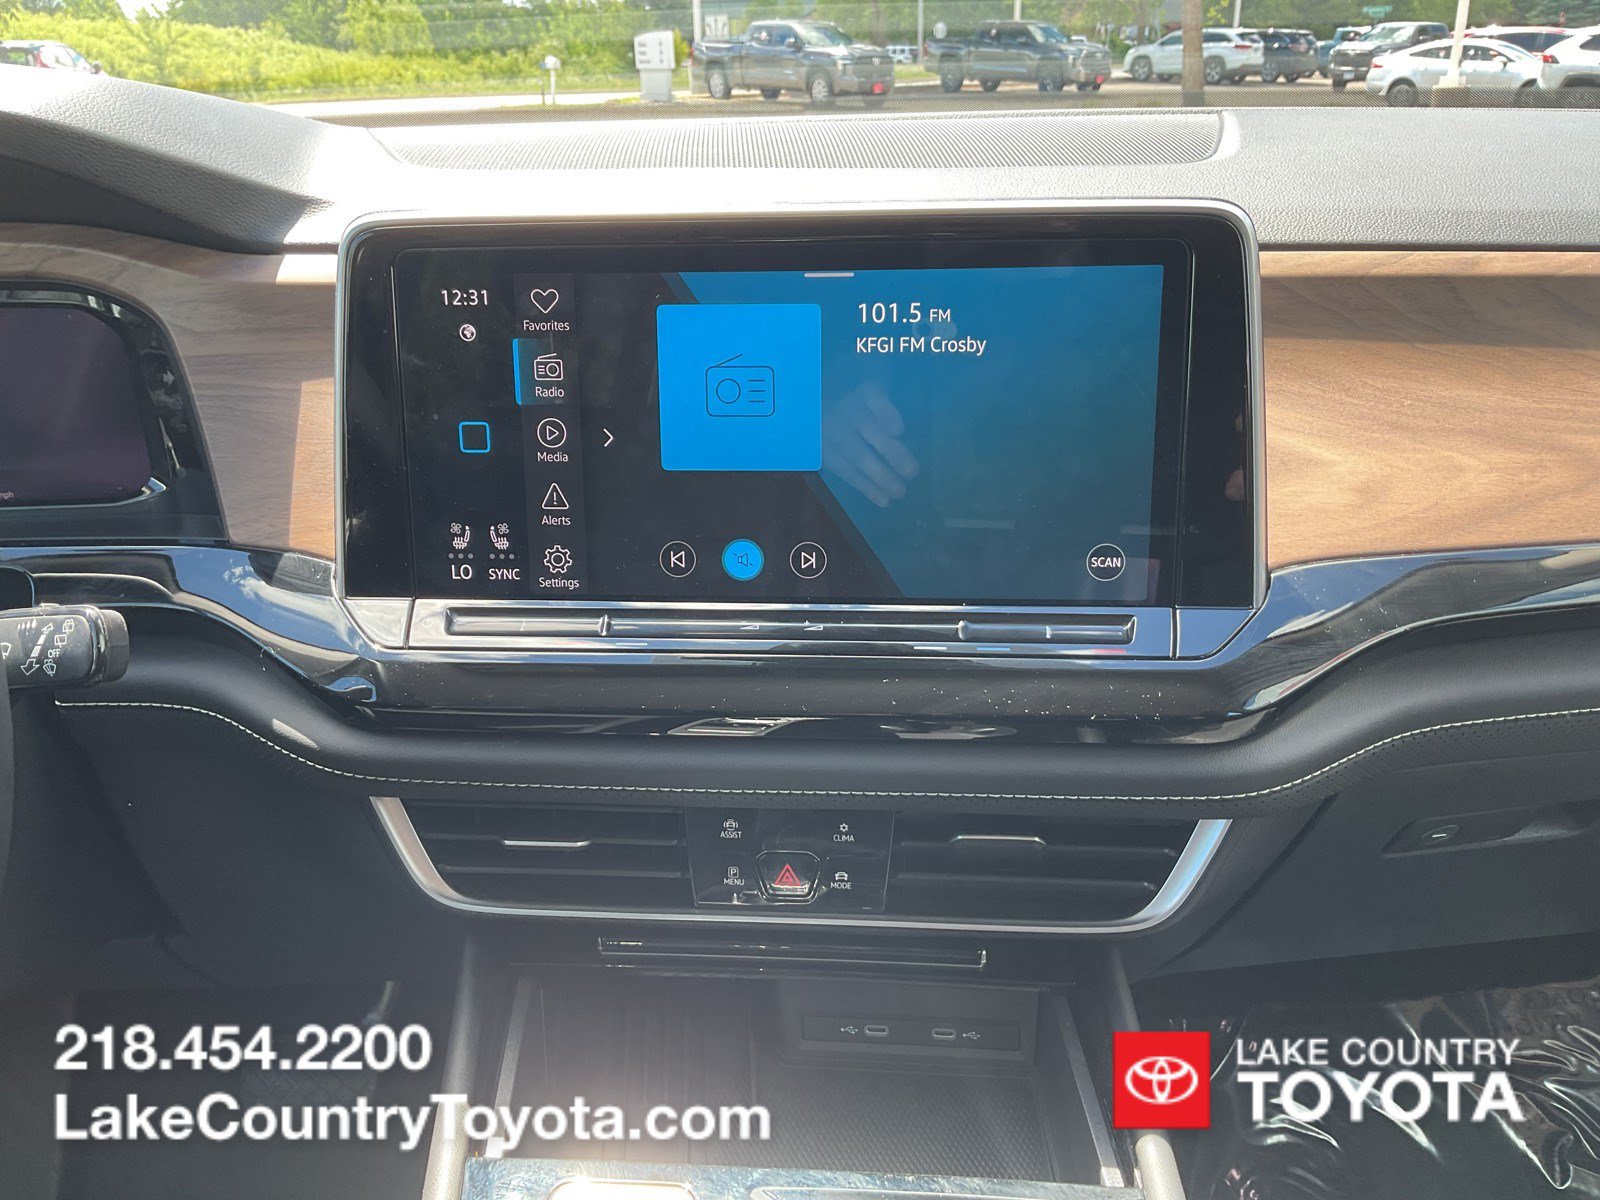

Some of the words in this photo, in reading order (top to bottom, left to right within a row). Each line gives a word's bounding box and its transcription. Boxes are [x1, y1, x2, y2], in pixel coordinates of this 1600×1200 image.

[440, 289, 489, 306] 12:31
[857, 302, 922, 324] 101.5
[929, 308, 952, 323] FM
[522, 319, 570, 331] Favorites
[856, 337, 894, 354] KFGI
[899, 337, 926, 353] FM
[930, 335, 987, 356] Crosby
[535, 386, 565, 398] Radio
[537, 451, 569, 462] Media
[541, 514, 571, 526] Alerts
[1090, 555, 1122, 569] SCAN
[451, 564, 473, 580] LO
[488, 568, 521, 581] SYNC
[538, 576, 580, 590] Settings
[47, 648, 62, 658] OFF
[719, 830, 742, 839] ASSIST
[832, 834, 855, 843] CLIMA
[723, 877, 745, 886] MENU
[830, 881, 852, 890] MODE
